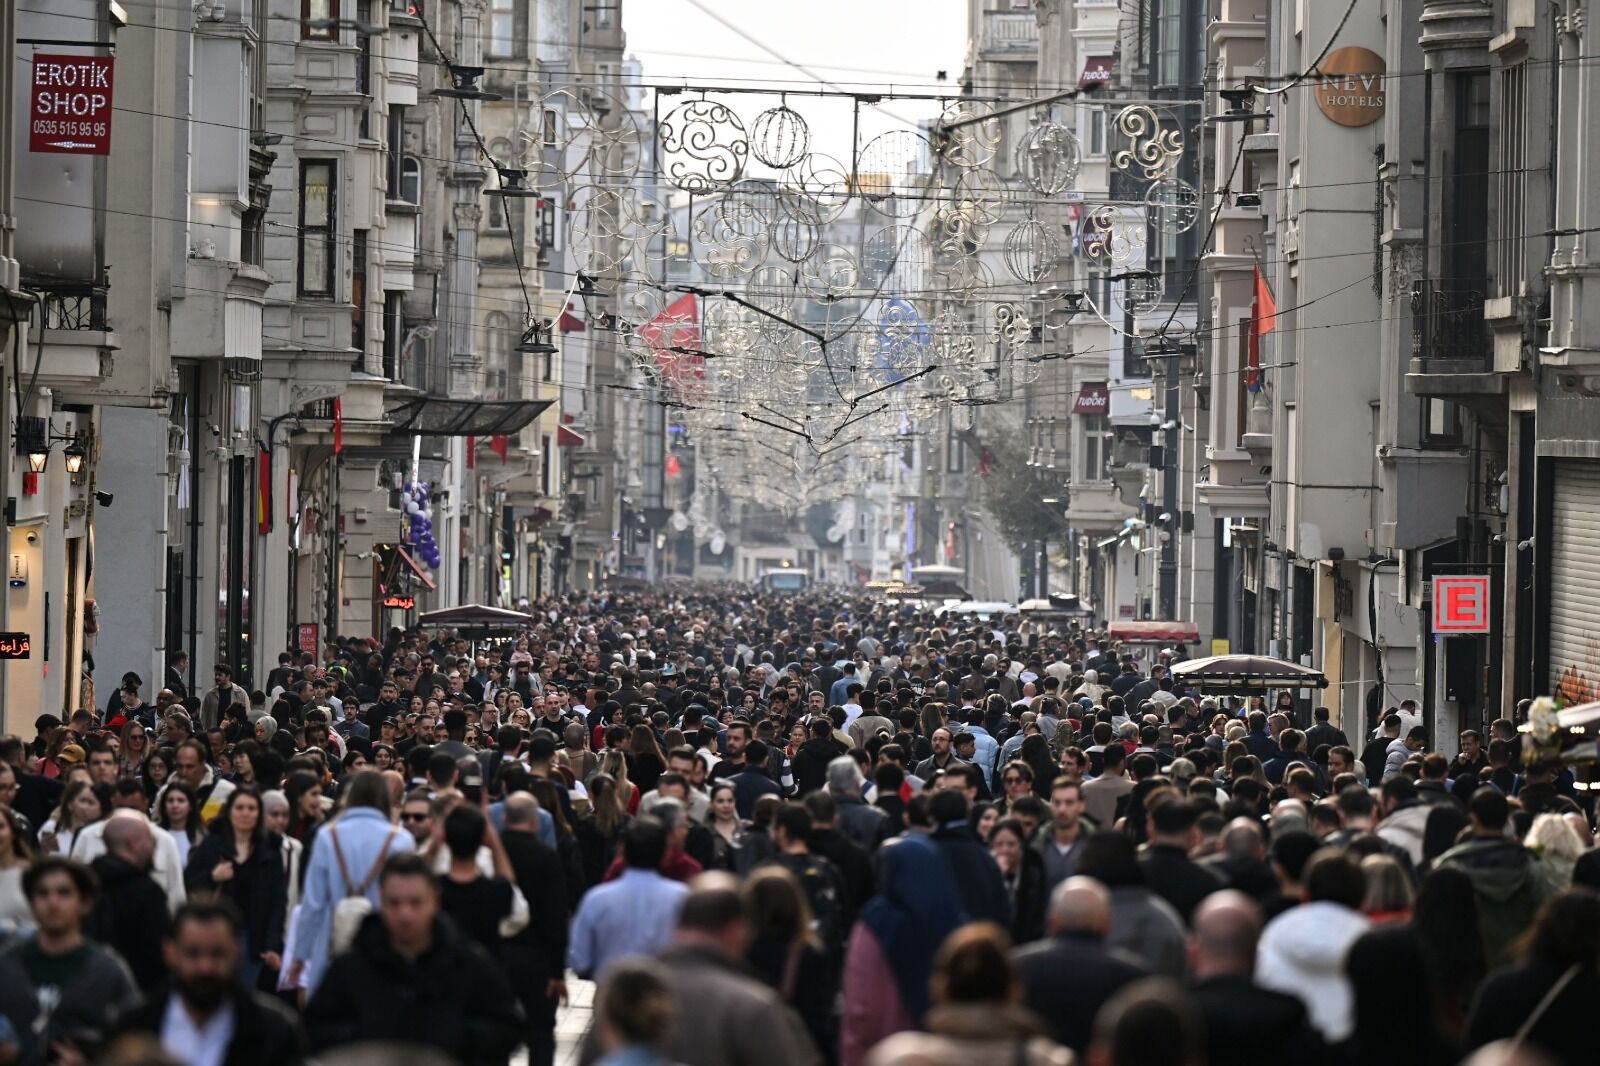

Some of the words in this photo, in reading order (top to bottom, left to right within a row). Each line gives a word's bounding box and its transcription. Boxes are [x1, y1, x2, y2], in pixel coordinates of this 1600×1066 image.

[35, 61, 109, 88] EROTİK
[37, 91, 106, 116] SHOP
[1326, 95, 1383, 107] HOTELS
[33, 119, 57, 135] 0535
[59, 121, 77, 136] 515
[79, 122, 92, 136] 95
[93, 122, 106, 137] 95
[1078, 396, 1106, 406] TUDORS
[1447, 587, 1475, 620] E
